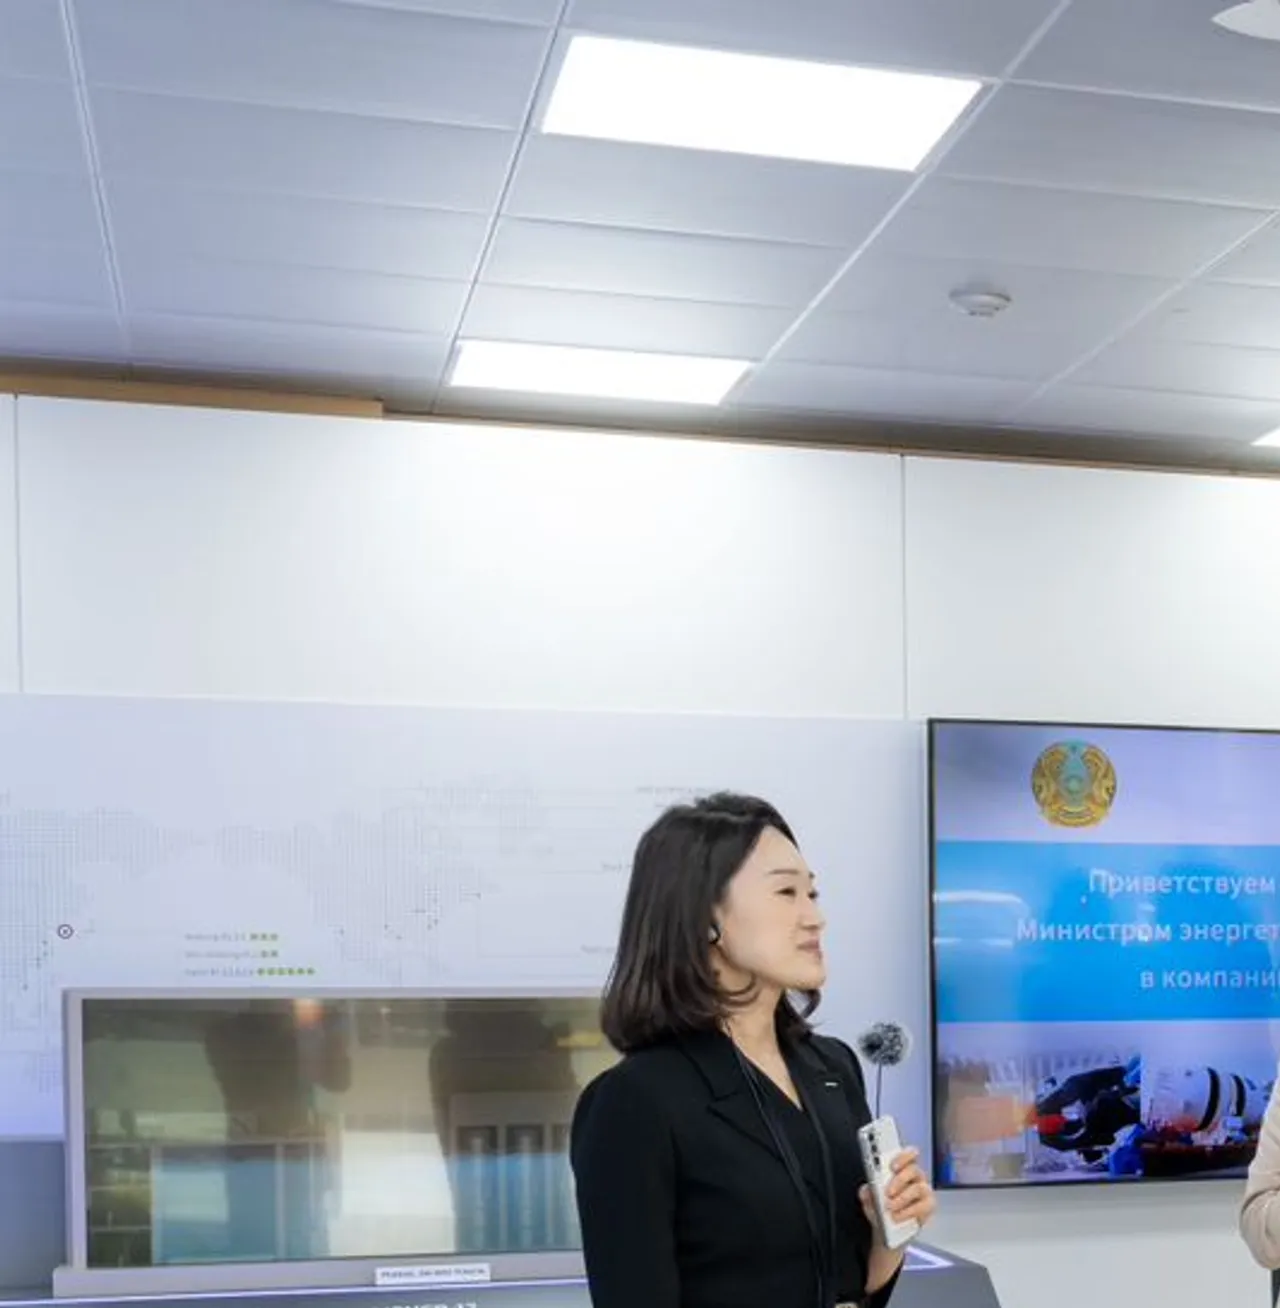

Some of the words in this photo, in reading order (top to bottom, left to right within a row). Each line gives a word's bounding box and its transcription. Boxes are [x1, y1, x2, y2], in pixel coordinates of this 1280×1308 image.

[1088, 868, 1276, 898] Приветствуем
[1016, 918, 1172, 946] Министром
[1139, 972, 1155, 988] в
